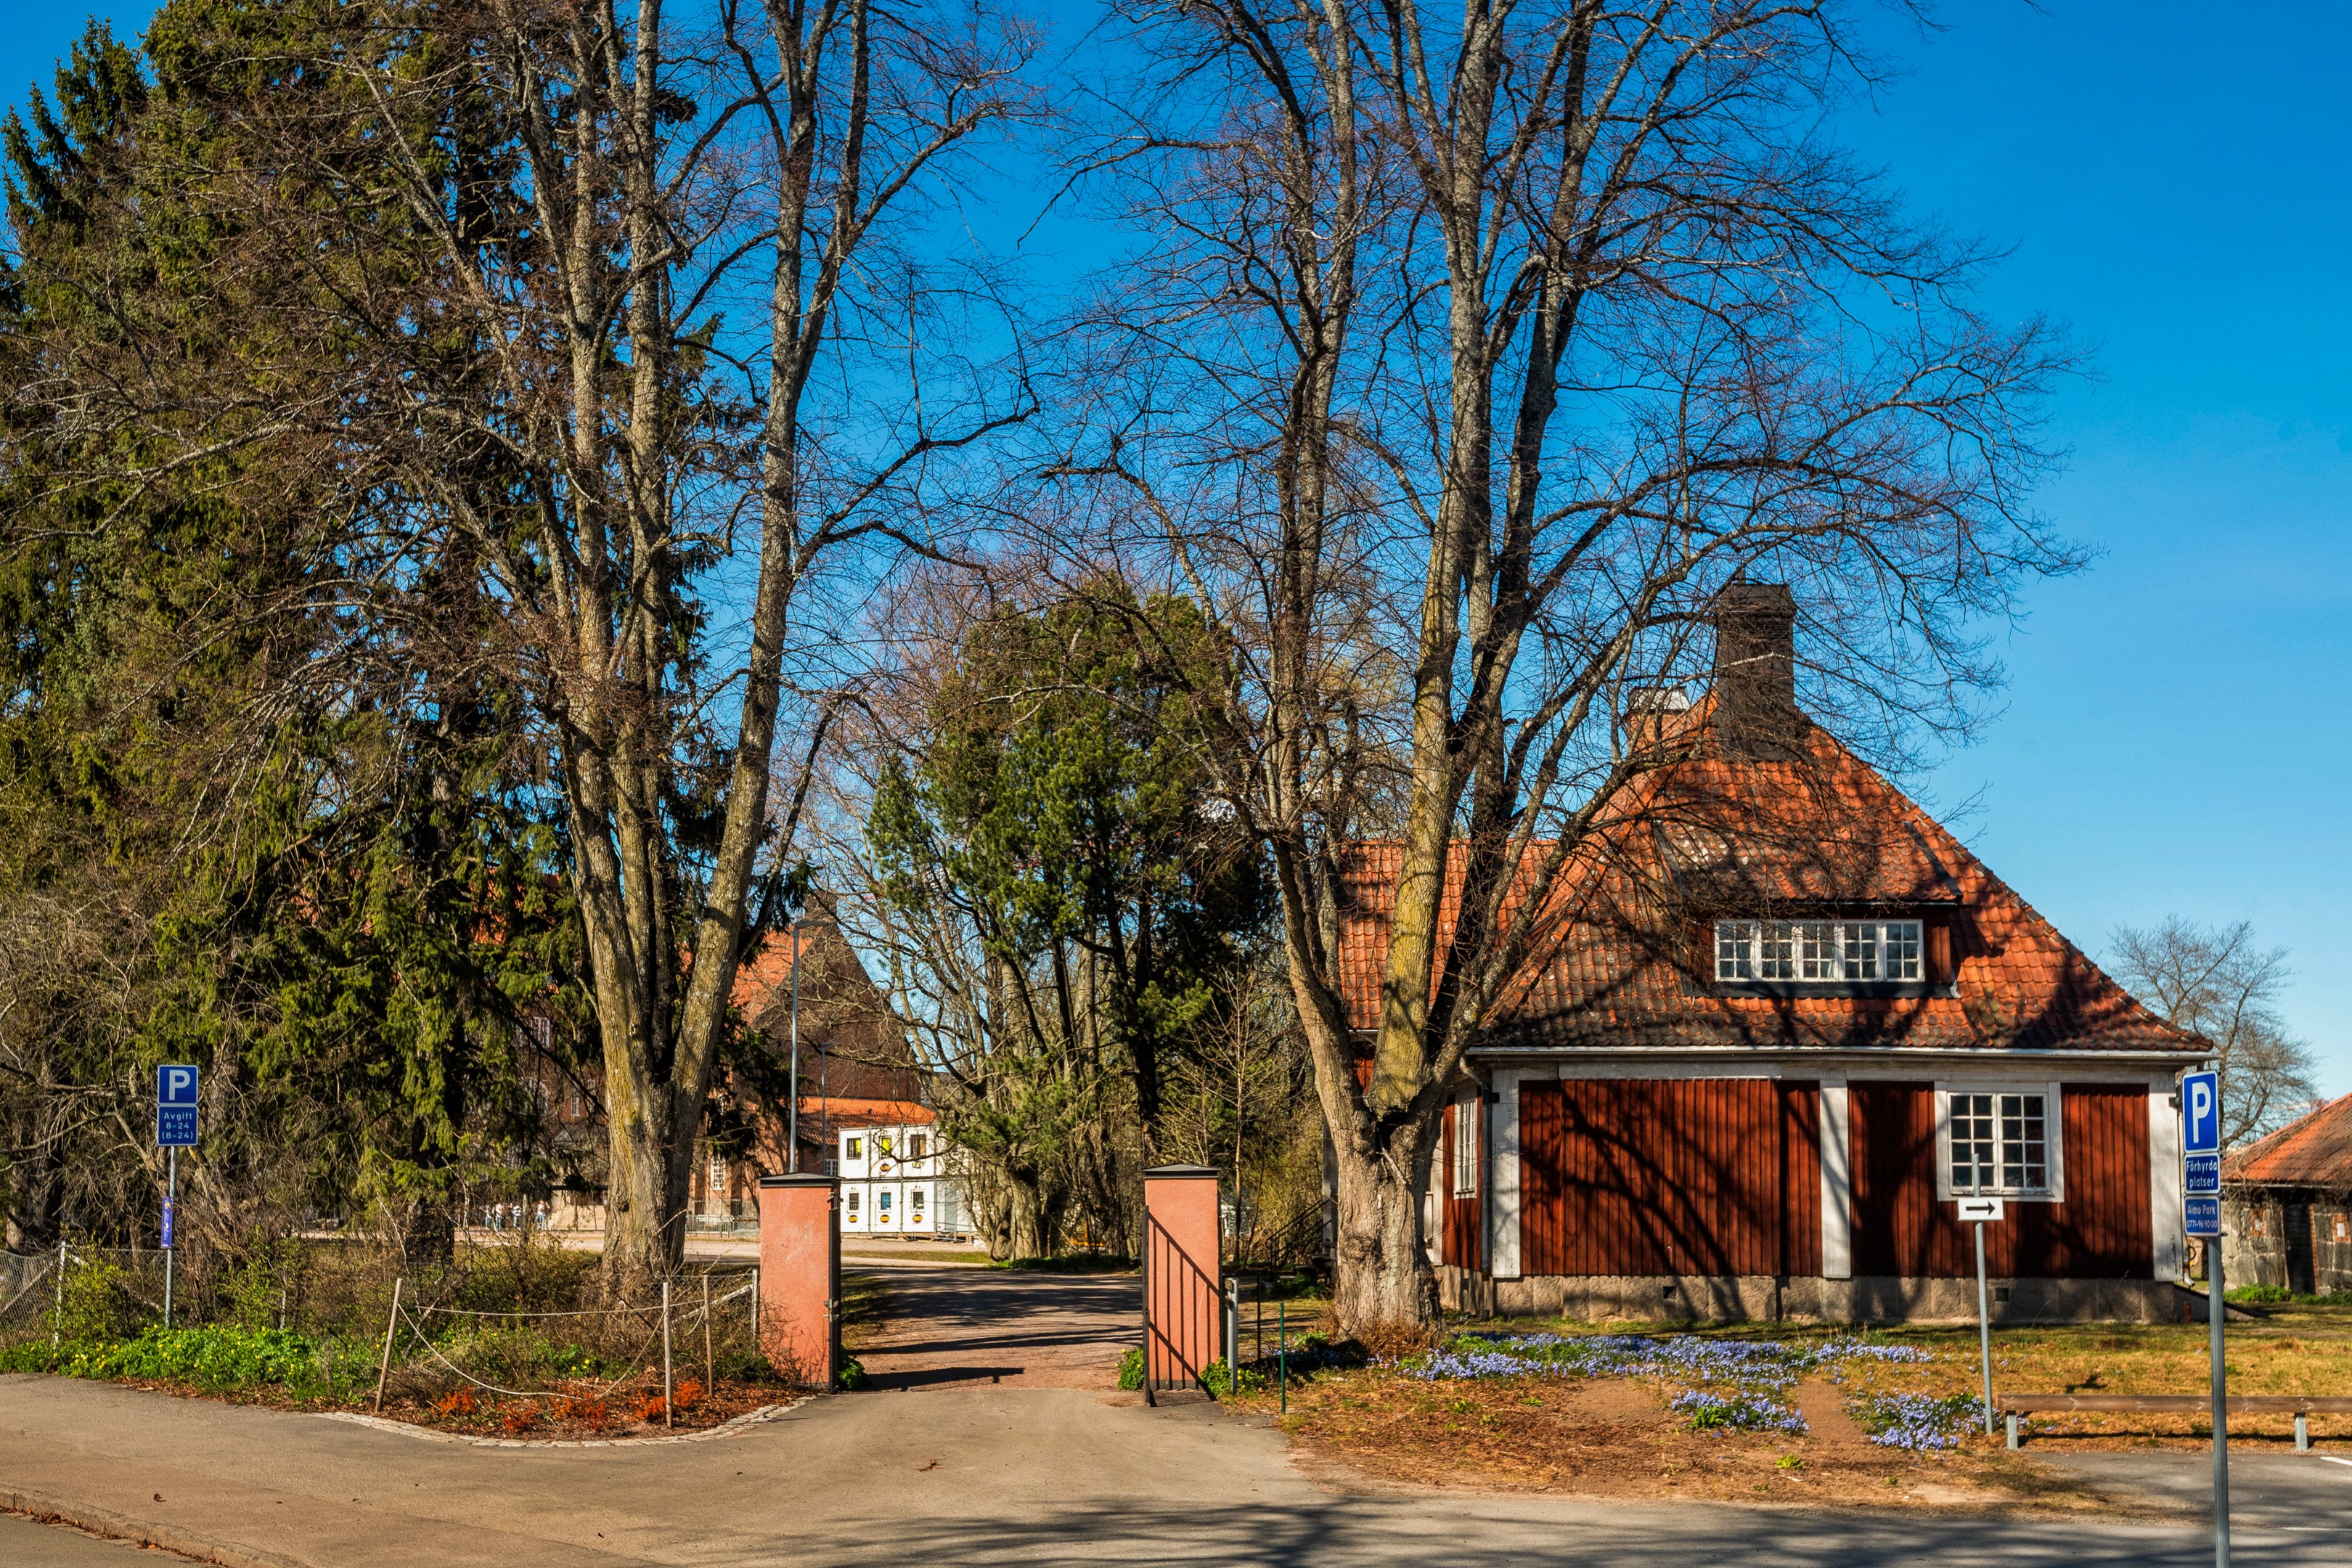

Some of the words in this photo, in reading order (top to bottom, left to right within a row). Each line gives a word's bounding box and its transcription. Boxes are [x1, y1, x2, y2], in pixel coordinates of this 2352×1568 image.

[169, 1069, 190, 1101] P
[164, 1112, 192, 1122] Avgift
[2192, 1082, 2211, 1144] P
[162, 1131, 193, 1140] (8-24)
[2186, 1159, 2218, 1174] Förhyrda
[2189, 1176, 2215, 1190] platser
[2187, 1204, 2202, 1214] Aimo
[2202, 1204, 2216, 1214] Park
